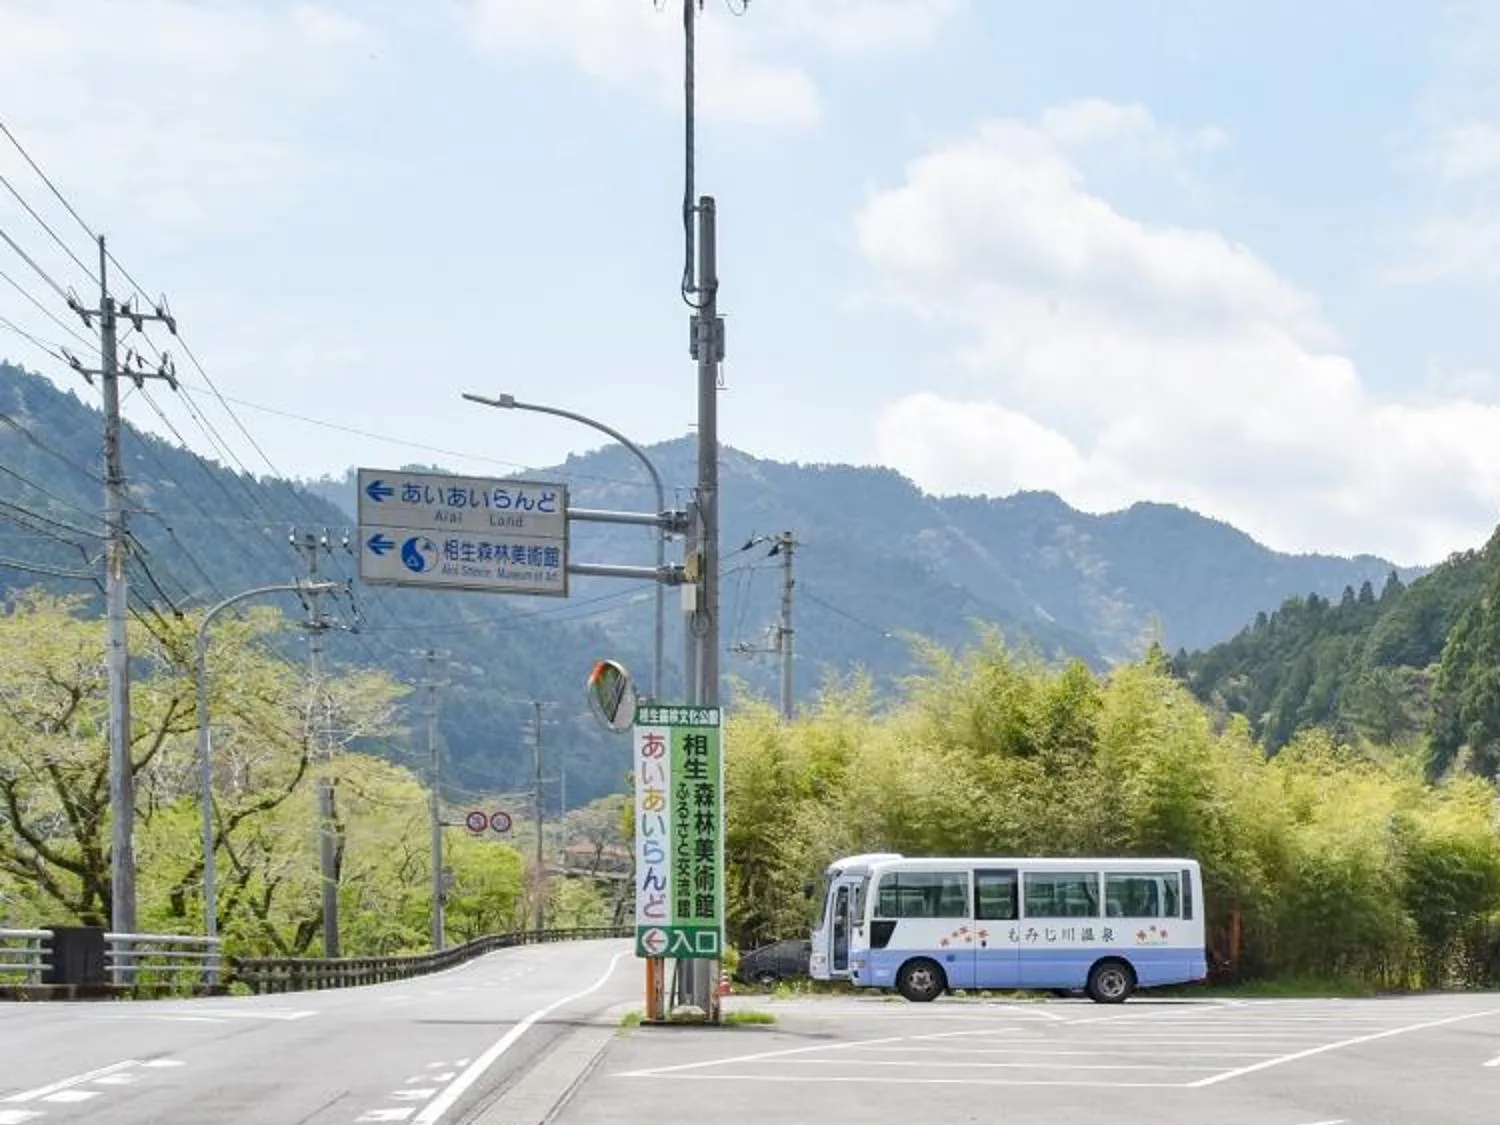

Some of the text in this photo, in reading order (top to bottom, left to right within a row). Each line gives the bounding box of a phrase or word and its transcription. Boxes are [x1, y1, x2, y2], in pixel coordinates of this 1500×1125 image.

[401, 481, 556, 513] あいあいらんど
[489, 515, 524, 529] Land
[444, 539, 560, 569] 相生森林美術館
[641, 732, 667, 919] あいあいらんど
[671, 931, 717, 953] 入口
[1008, 927, 1115, 943] もみじ川温泉
